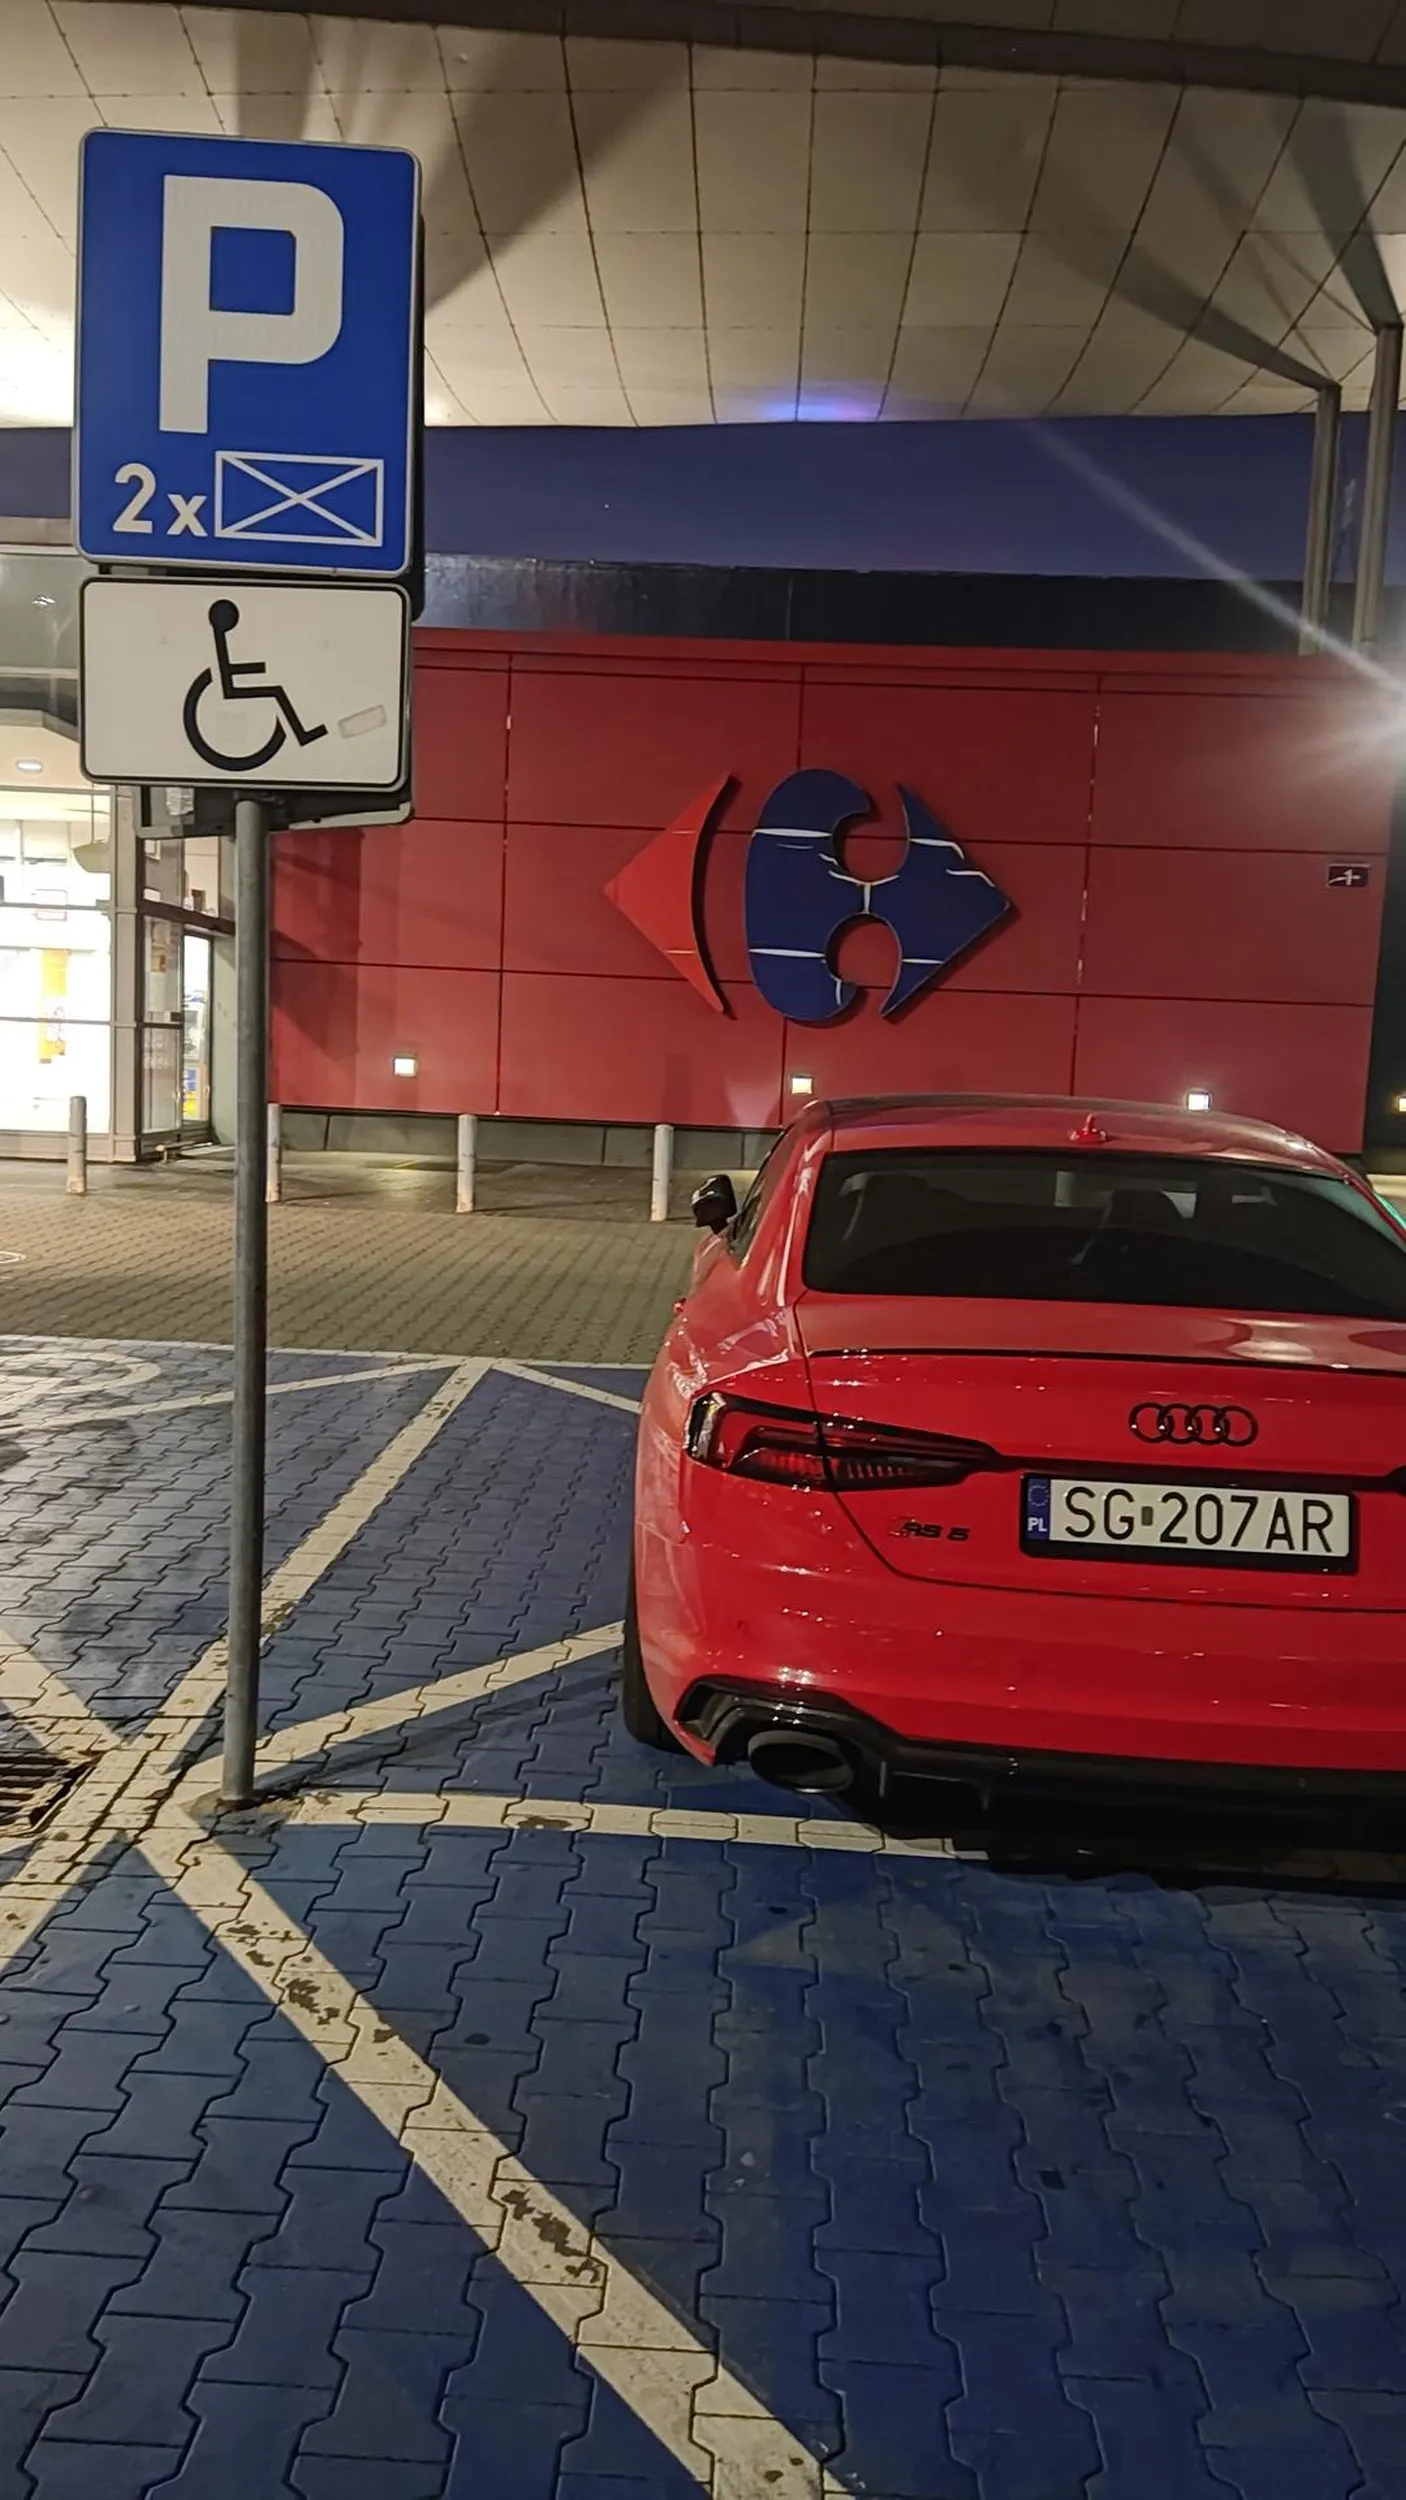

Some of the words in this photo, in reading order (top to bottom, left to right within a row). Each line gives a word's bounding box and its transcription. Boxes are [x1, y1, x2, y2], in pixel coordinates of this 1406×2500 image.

[159, 174, 344, 434] P
[1027, 1516, 1048, 1532] PL
[1065, 1486, 1135, 1540] SG
[1159, 1491, 1333, 1553] 207AR
